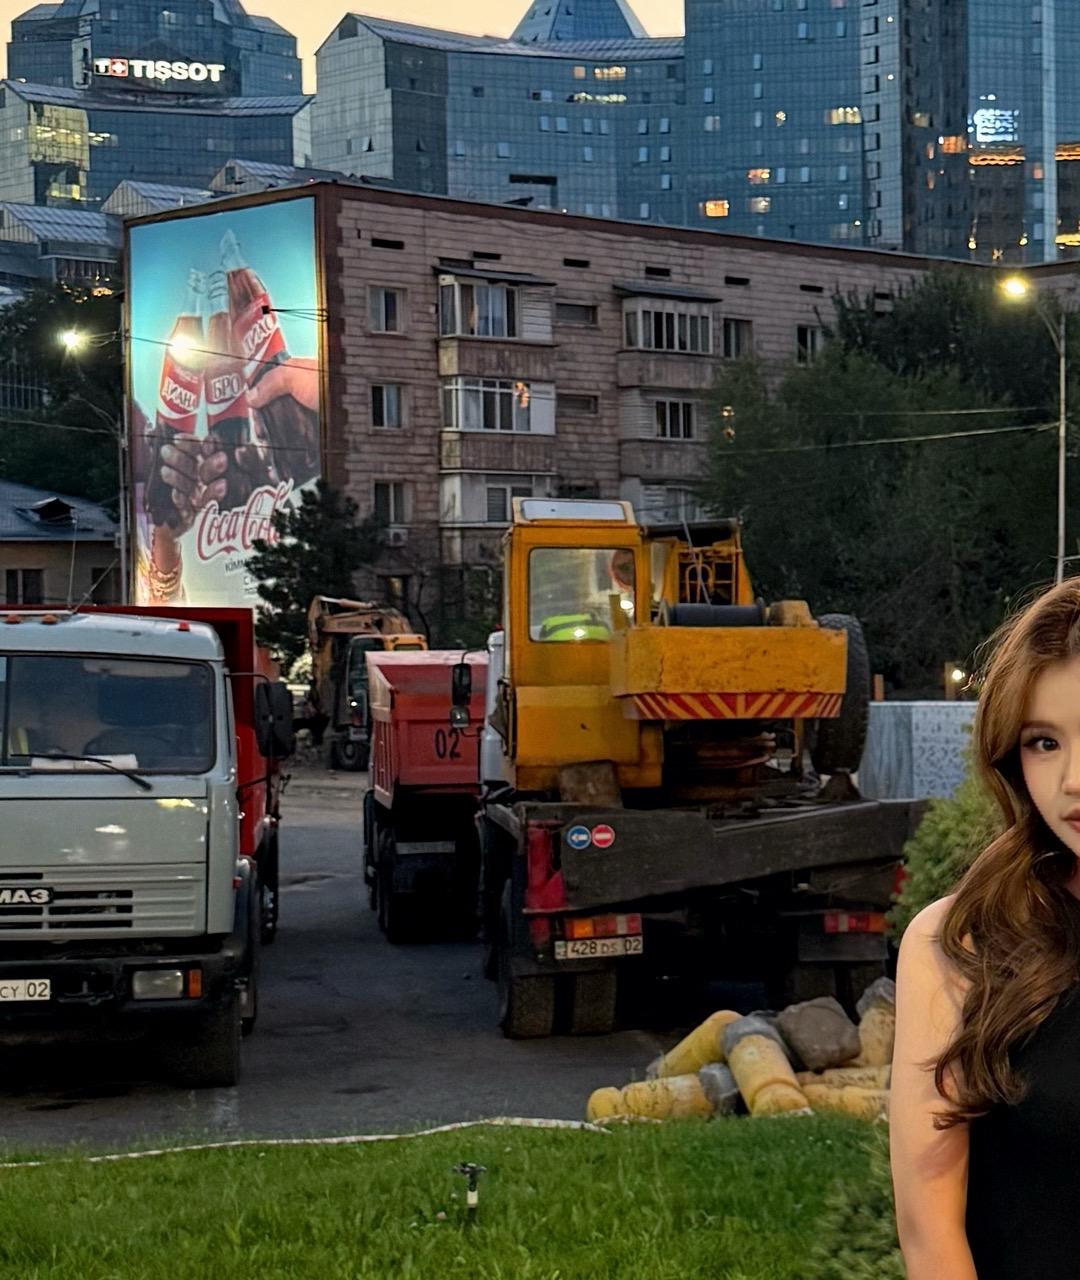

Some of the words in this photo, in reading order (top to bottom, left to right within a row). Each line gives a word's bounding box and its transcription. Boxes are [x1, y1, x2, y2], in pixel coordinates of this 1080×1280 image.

[130, 60, 225, 82] TISSOT
[435, 728, 461, 759] 02
[571, 941, 597, 955] 428
[624, 939, 641, 952] 02
[27, 982, 48, 998] 02
